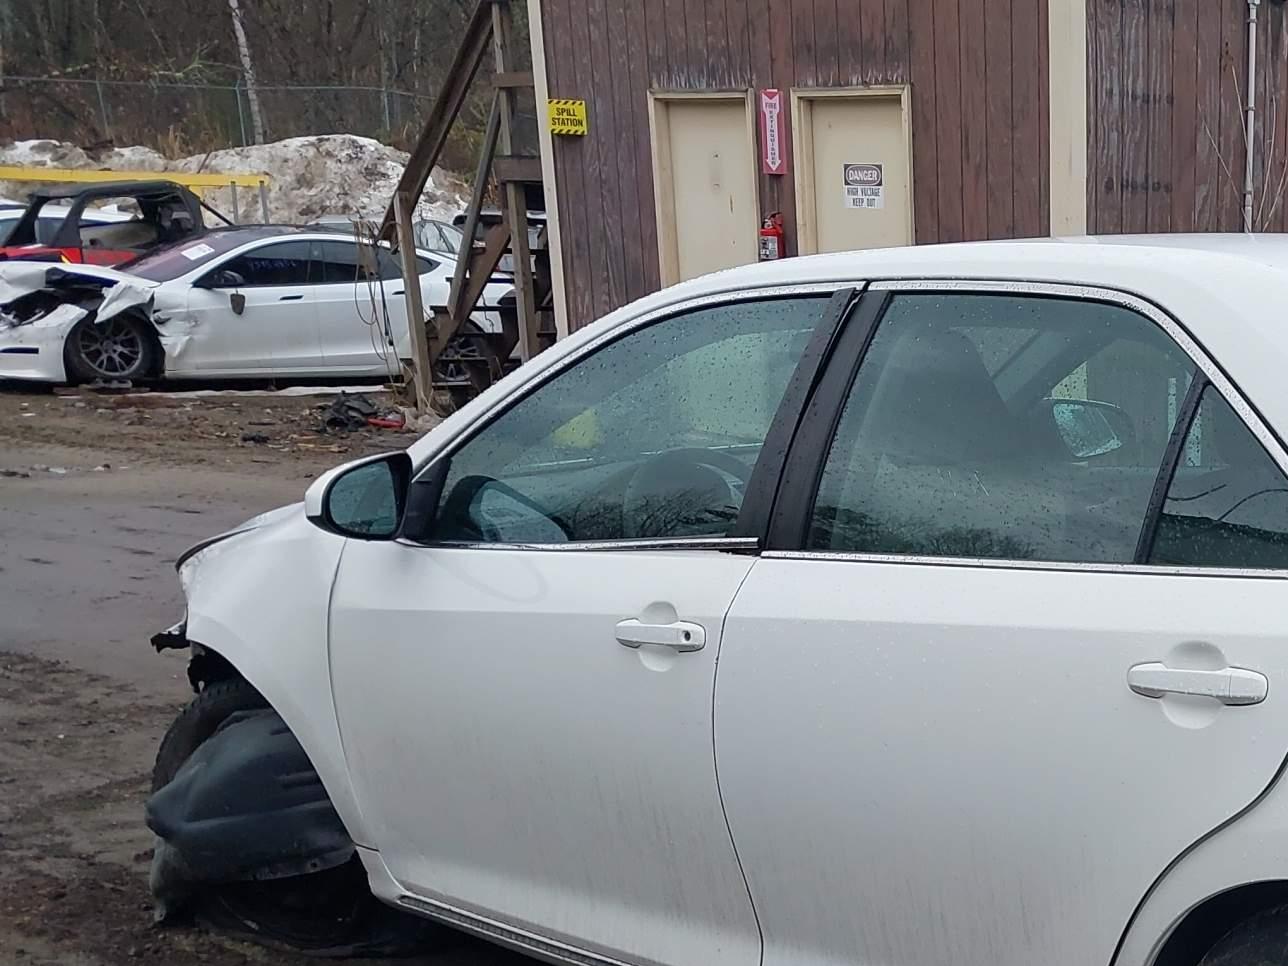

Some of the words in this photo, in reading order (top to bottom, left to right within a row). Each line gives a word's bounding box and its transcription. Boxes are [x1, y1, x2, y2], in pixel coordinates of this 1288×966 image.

[556, 108, 577, 117] SPILL
[551, 117, 584, 127] STATION
[849, 170, 877, 181] DANGER
